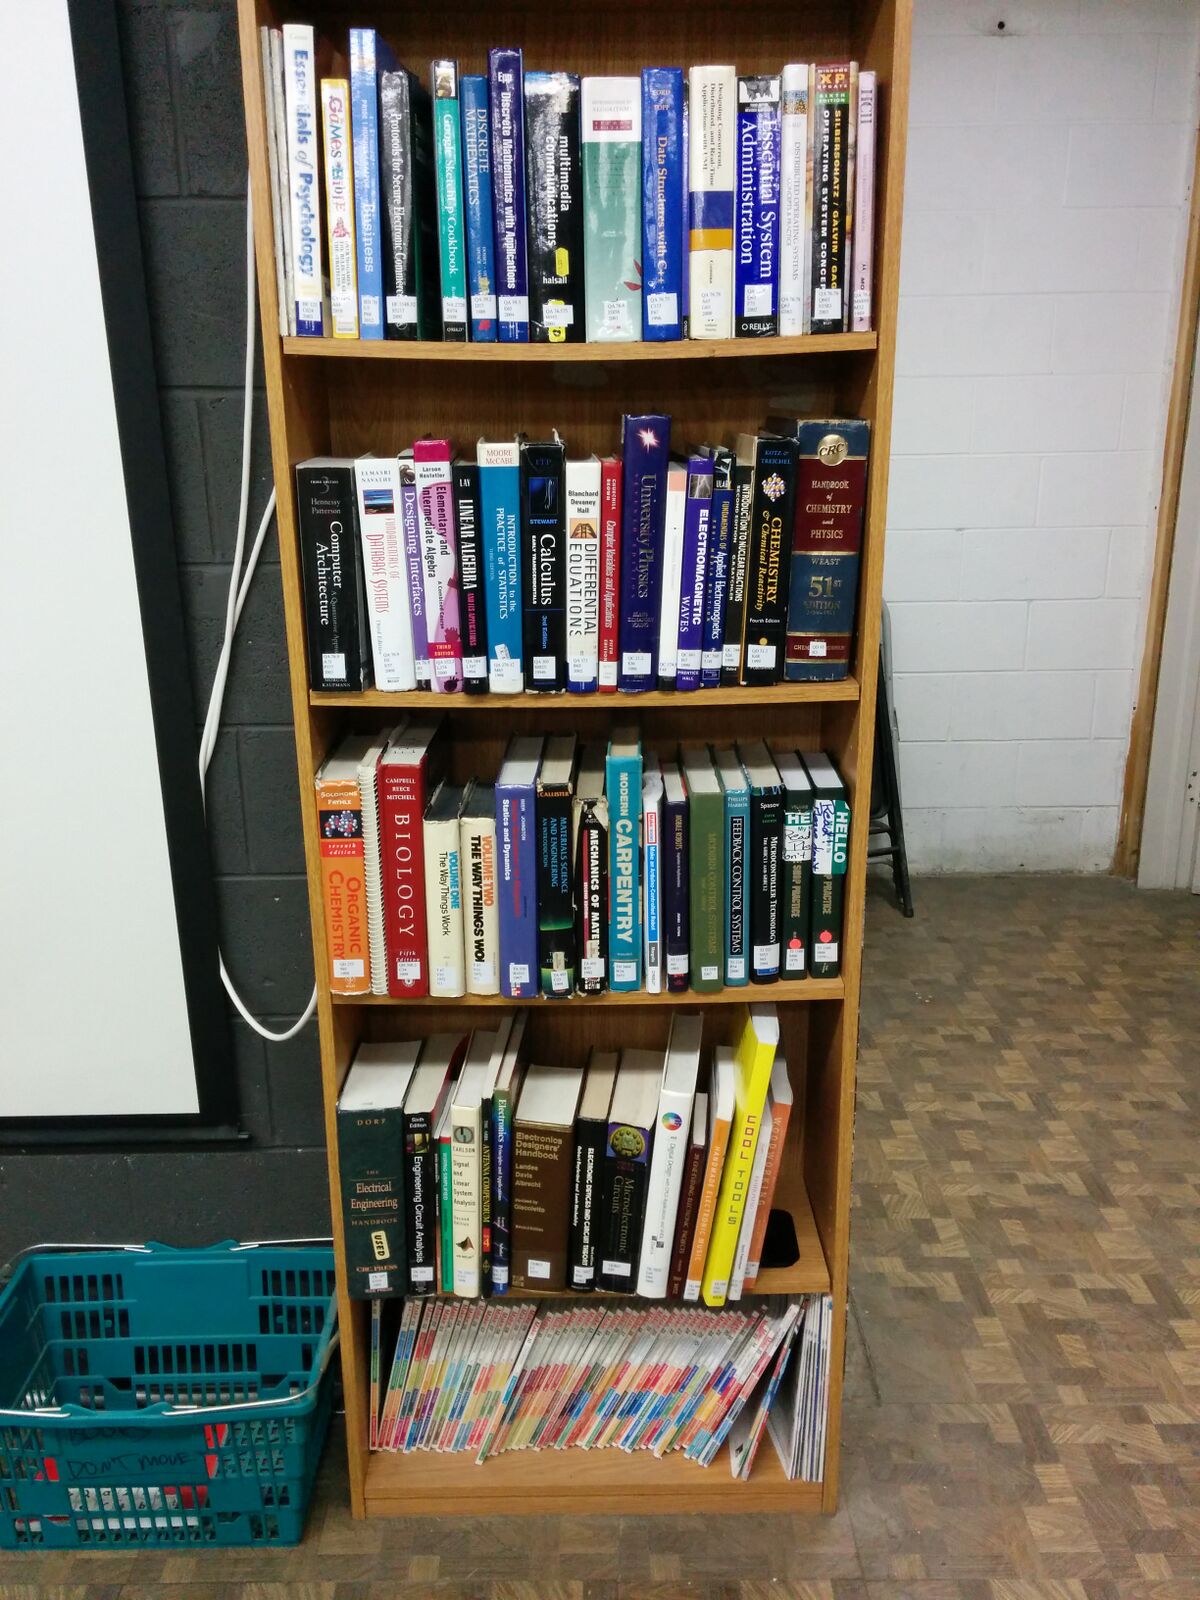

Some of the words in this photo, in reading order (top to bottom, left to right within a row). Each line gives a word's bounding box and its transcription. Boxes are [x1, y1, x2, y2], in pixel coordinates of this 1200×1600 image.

[389, 113, 402, 156] Protocols
[443, 114, 455, 157] Google
[501, 92, 513, 136] Discrete
[467, 109, 479, 205] MATHEMATICS
[477, 109, 488, 173] DISCRETE
[657, 136, 667, 164] Data
[760, 120, 776, 204] Essential
[822, 110, 830, 183] OPERATING
[832, 110, 841, 198] SILBERSCHATZ
[392, 159, 403, 173] for
[502, 139, 514, 204] Mathematics
[559, 135, 571, 211] multimedia
[392, 175, 404, 204] Secure
[545, 135, 557, 246] communications
[657, 168, 667, 227] Structures
[741, 120, 757, 264] Administration
[295, 173, 316, 276] Psychology
[363, 204, 375, 272] Business
[393, 206, 405, 250] Electronic
[504, 206, 515, 229] with
[831, 211, 839, 254] GALVIN
[447, 217, 459, 274] Cookbook
[504, 231, 517, 289] Applications
[658, 230, 667, 257] with
[759, 211, 775, 278] System
[395, 252, 406, 297] Commerce
[543, 276, 567, 284] halsall
[657, 260, 667, 284] C++
[819, 443, 844, 457] CRC
[311, 498, 340, 507] Hennessy
[812, 480, 849, 489] HANDBOOK
[404, 492, 418, 553] Designing
[422, 487, 434, 544] Intermediate
[435, 487, 448, 537] Elementary
[459, 500, 474, 538] LINEAR
[636, 474, 657, 545] University
[739, 484, 750, 530] INTRODUCTION
[806, 504, 851, 514] CHEMISTRY
[440, 540, 450, 555] and
[496, 508, 507, 553] PRACTICE
[508, 515, 517, 585] INTRODUCTION
[605, 520, 616, 547] Complex
[739, 532, 748, 540] TO
[758, 523, 769, 565] Chemical
[810, 530, 843, 539] PHYSICS
[329, 521, 343, 588] Computer
[365, 534, 386, 576] DATABASE
[425, 546, 437, 578] Algebra
[461, 542, 476, 590] ALGEBRA
[498, 557, 505, 565] of
[540, 534, 556, 605] Calculus
[605, 549, 616, 576] Variables
[637, 548, 655, 599] Physics
[692, 509, 709, 625] ELECTROMAGNETIC
[715, 551, 729, 578] Applied
[736, 541, 747, 568] NUCLEAR
[767, 517, 782, 604] CHEMISTRY
[316, 543, 331, 625] Architecture
[410, 558, 422, 616] Interfaces
[498, 570, 508, 620] STATISTICS
[569, 543, 582, 636] EQUATIONS
[584, 543, 598, 635] DIFFERENTIAL
[606, 578, 615, 590] and
[734, 569, 745, 601] REACTIONS
[755, 568, 767, 611] Reactivity
[604, 591, 614, 628] Applications
[680, 596, 691, 632] WAVES
[711, 580, 726, 640] Electromagnetics
[502, 799, 510, 826] Statics
[619, 772, 629, 816] MODERN
[470, 835, 482, 859] THE
[550, 817, 558, 835] AND
[559, 817, 568, 860] MATERIALS
[675, 833, 683, 850] ROBOTS
[732, 818, 742, 863] FEEDBACK
[834, 812, 848, 863] HELLO
[394, 813, 414, 937] BIOLOGY
[439, 852, 449, 867] The
[439, 869, 450, 886] Way
[449, 851, 458, 889] VOLUME
[472, 861, 483, 889] WAY
[482, 835, 493, 880] VOLUME
[502, 844, 512, 880] Dynamics
[551, 837, 559, 887] ENGINEERING
[561, 862, 569, 893] SCIENCE
[590, 830, 599, 891] MECHANICS
[440, 887, 451, 914] Things
[450, 890, 460, 909] ONE
[483, 882, 494, 906] TWO
[591, 895, 600, 908] OF
[616, 819, 633, 944] CARPENTRY
[732, 865, 742, 912] CONTROL
[791, 886, 801, 918] PRACTICE
[822, 882, 832, 914] PRACTICE
[328, 870, 345, 959] CHEMISTRY
[346, 877, 361, 953] ORGANIC
[442, 915, 451, 936] Work
[472, 890, 484, 936] THINGS
[731, 914, 742, 953] SYSTEMS
[770, 900, 778, 943] TECHNOLOGY
[497, 1099, 507, 1142] Electronics
[516, 1132, 562, 1144] Electronics
[740, 1115, 757, 1160] COOL
[482, 1144, 490, 1176] ANTENNA
[515, 1150, 558, 1160] Handbook
[585, 1148, 594, 1184] ELECTRONIC
[707, 1146, 721, 1188] HANDMADE
[758, 1117, 782, 1207] WOODWORKING
[356, 1181, 392, 1193] Electrical
[412, 1156, 423, 1202] Engineering
[482, 1177, 491, 1223] COMPENDIUM
[611, 1176, 624, 1214] Circuits
[727, 1170, 746, 1225] TOOLS
[351, 1198, 398, 1211] Engineering
[352, 1218, 398, 1226] HANDBOOK
[414, 1204, 424, 1230] Circuit
[618, 1177, 635, 1254] Microelectronic
[697, 1191, 713, 1237] ELECTRONIC
[374, 1235, 385, 1256] USED
[414, 1231, 425, 1263] Analysis
[694, 1238, 706, 1262] MUSIC
[67, 1456, 130, 1479] DON'T
